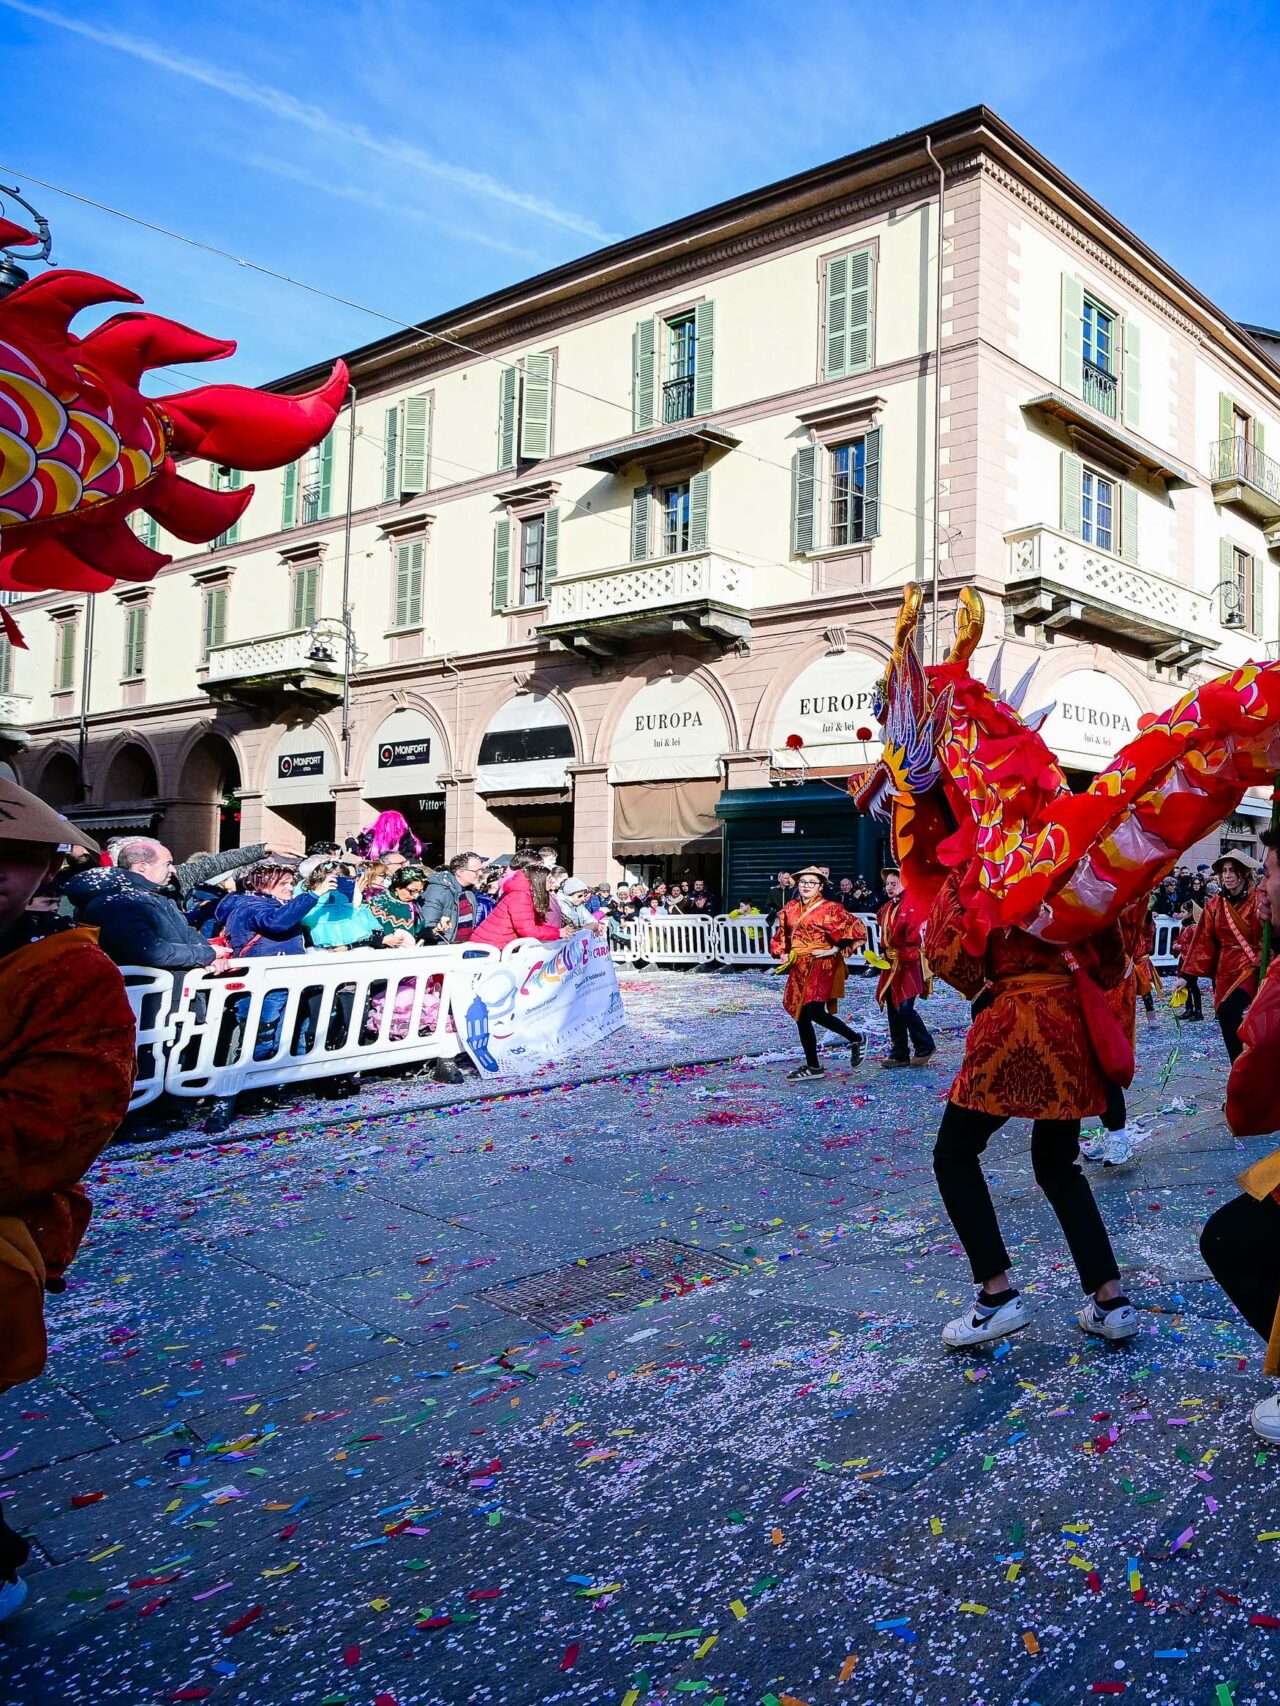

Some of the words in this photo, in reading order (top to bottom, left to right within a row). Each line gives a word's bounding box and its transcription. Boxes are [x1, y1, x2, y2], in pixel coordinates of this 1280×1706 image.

[635, 710, 703, 731] EUROPA
[1062, 702, 1131, 732] EUROPA
[822, 723, 834, 733] lui
[835, 722, 843, 732] &
[844, 721, 855, 731] lei
[653, 738, 663, 747] lui
[664, 738, 670, 747] &
[672, 738, 681, 746] lei
[1084, 733, 1094, 743] lui
[1095, 736, 1101, 745] &
[1103, 737, 1112, 746] lei
[394, 743, 428, 755] MONFORT
[293, 756, 322, 767] MONFORT
